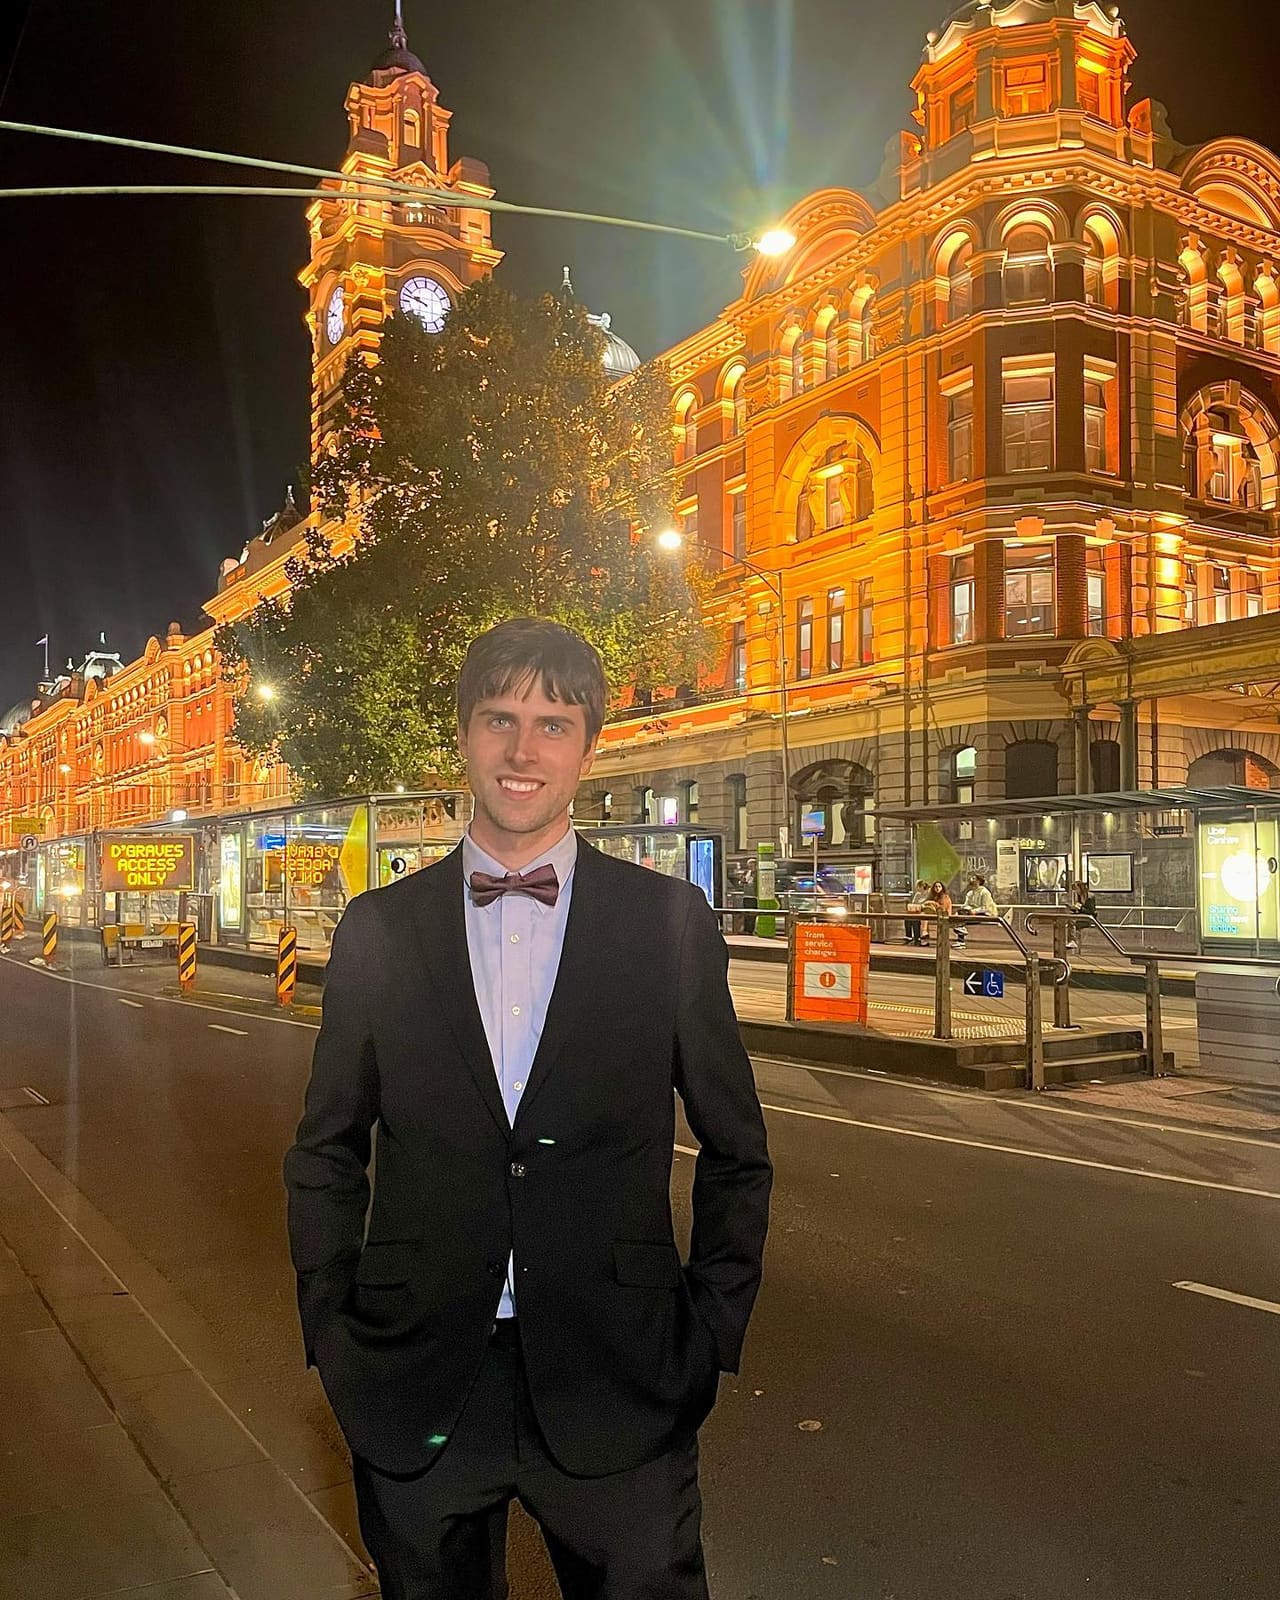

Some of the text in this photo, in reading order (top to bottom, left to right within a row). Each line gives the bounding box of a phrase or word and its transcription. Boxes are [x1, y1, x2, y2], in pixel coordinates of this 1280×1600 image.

[111, 844, 184, 858] D'GRAVES
[117, 858, 177, 872] ACCESS
[127, 872, 167, 886] ONLY
[804, 931, 825, 939] Tram
[804, 940, 833, 948] service
[804, 948, 837, 957] changes
